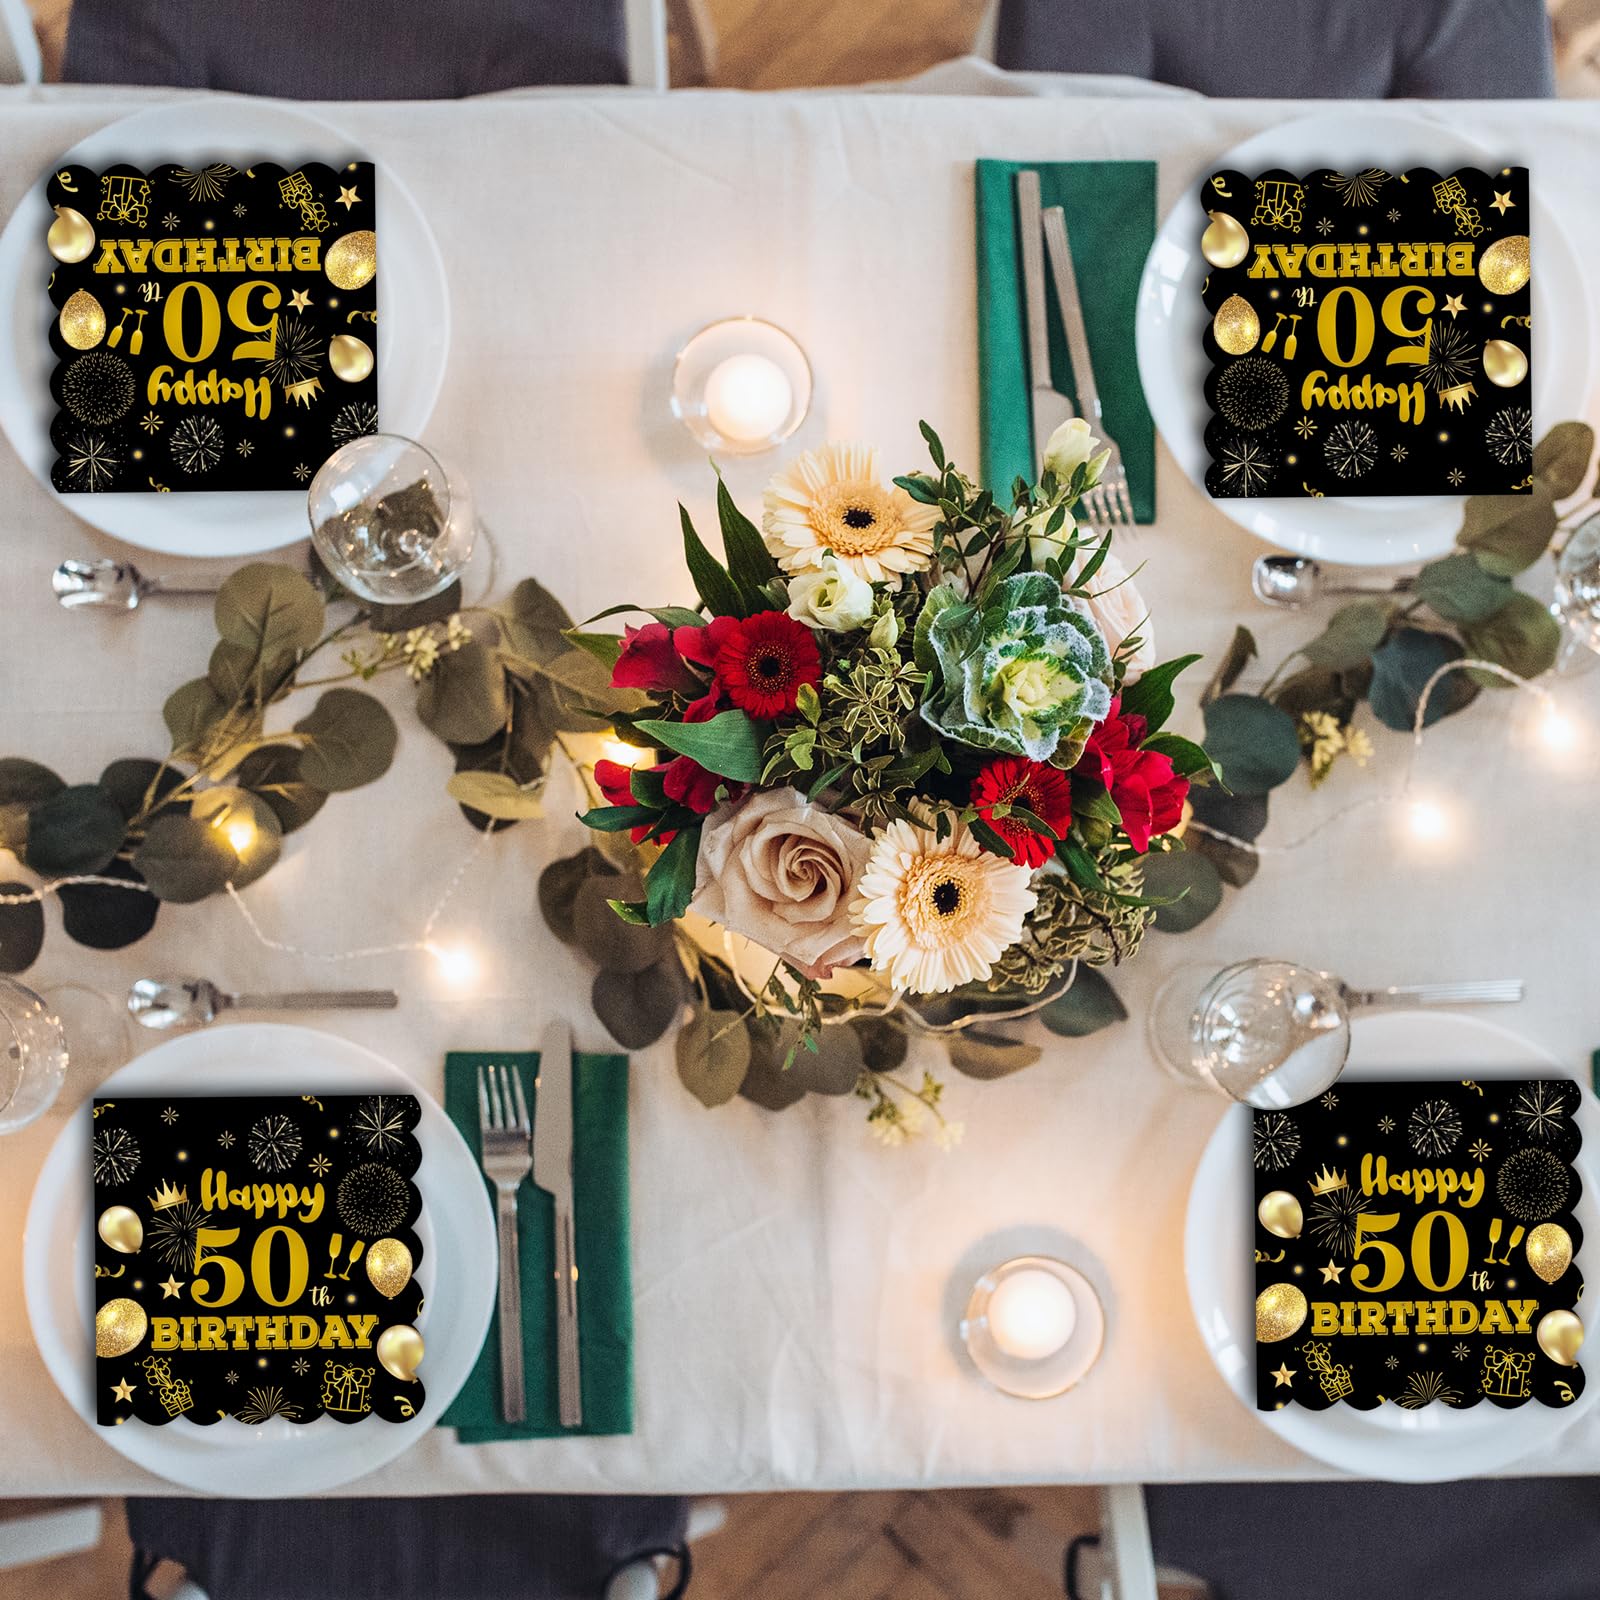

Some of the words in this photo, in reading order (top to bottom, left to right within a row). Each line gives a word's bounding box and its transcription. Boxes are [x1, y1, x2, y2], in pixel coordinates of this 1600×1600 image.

[94, 237, 321, 273] BIRTHDAY
[1247, 242, 1475, 278] BIRTHDAY
[147, 365, 271, 420] Happy
[1301, 370, 1425, 425] Happy
[201, 1168, 325, 1223] Happy
[1361, 1153, 1485, 1208] Happy
[151, 1315, 379, 1350] BIRTHDAY
[1311, 1300, 1539, 1335] BIRTHDAY
